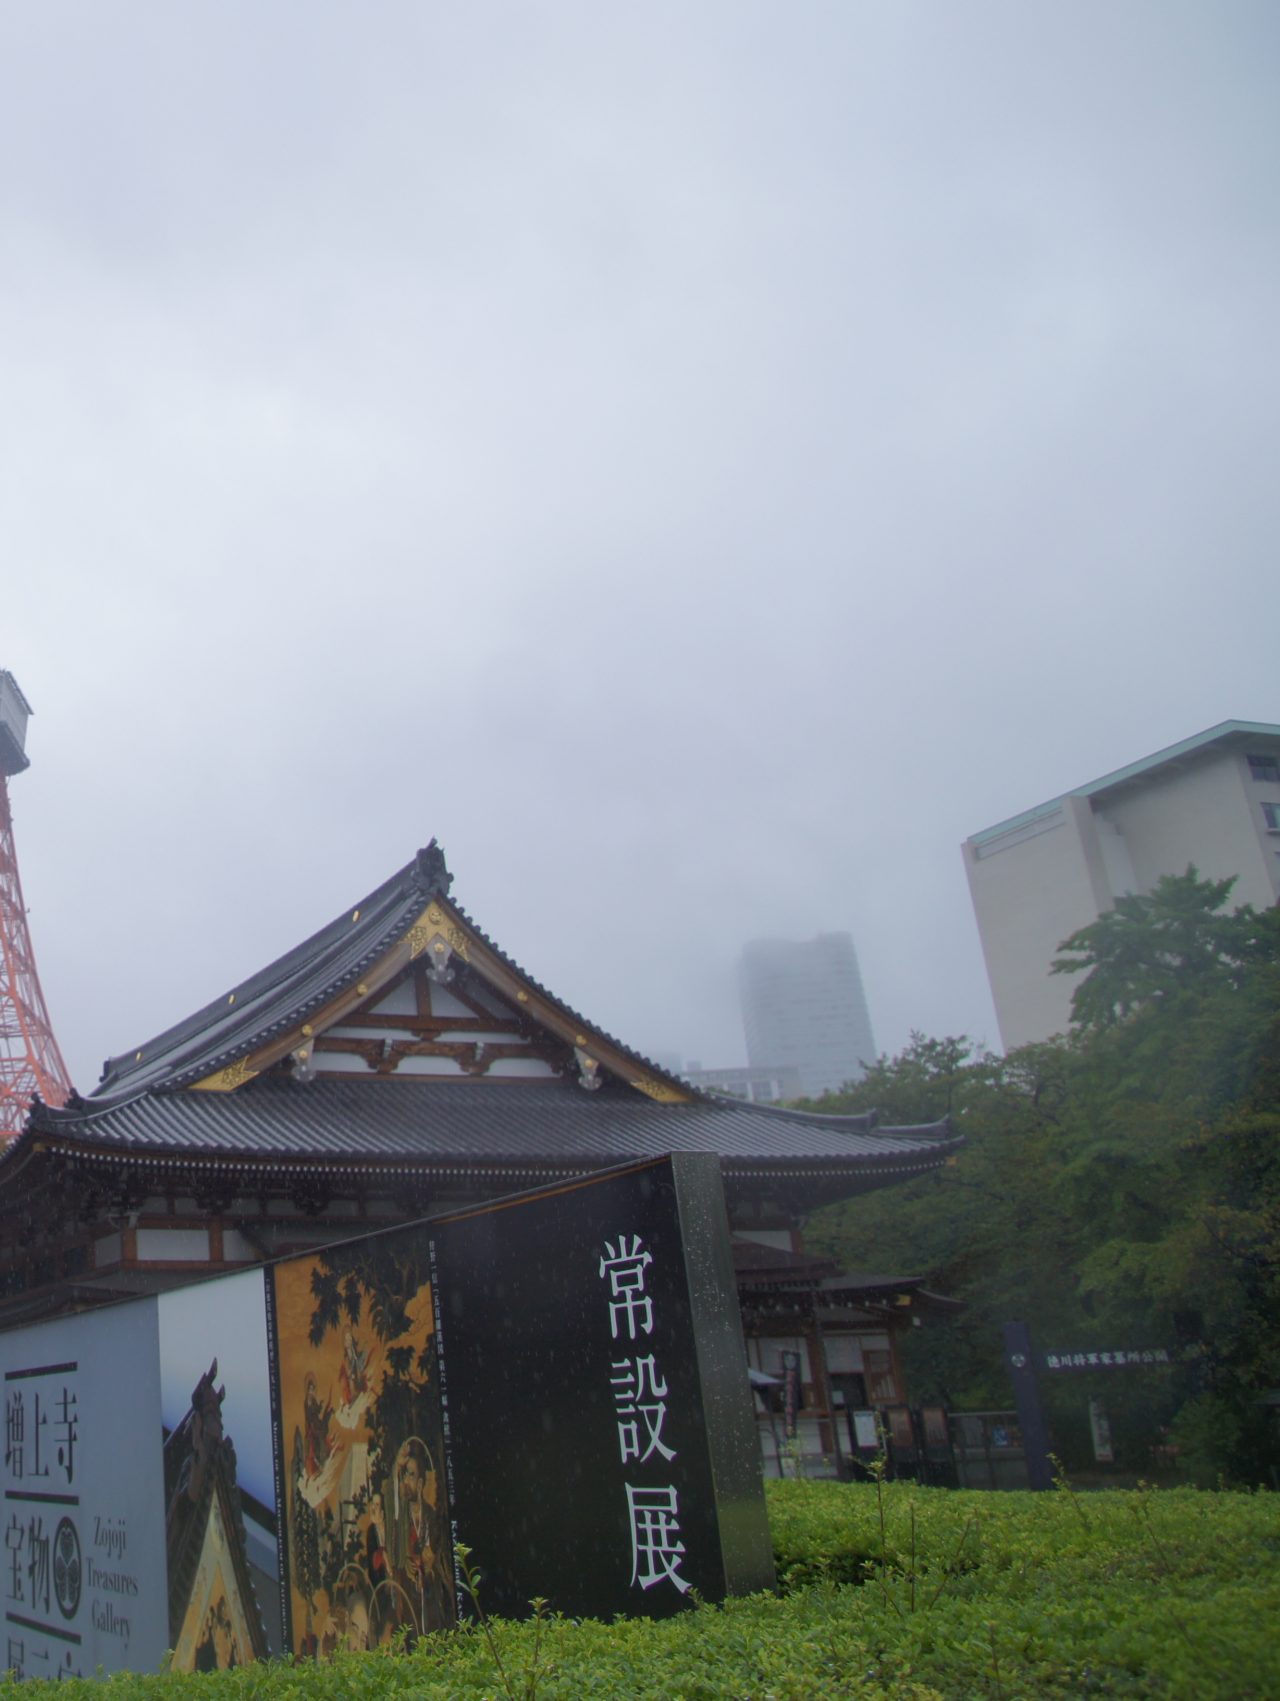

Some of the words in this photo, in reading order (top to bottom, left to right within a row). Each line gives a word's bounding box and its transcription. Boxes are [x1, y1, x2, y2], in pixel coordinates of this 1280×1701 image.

[4, 1387, 79, 1486] 増上寺
[599, 1233, 692, 1594] 常設展
[4, 1512, 51, 1615] 宝物
[93, 1515, 127, 1561] Zojoji
[86, 1558, 138, 1597] Treasures
[91, 1598, 132, 1650] Gallery
